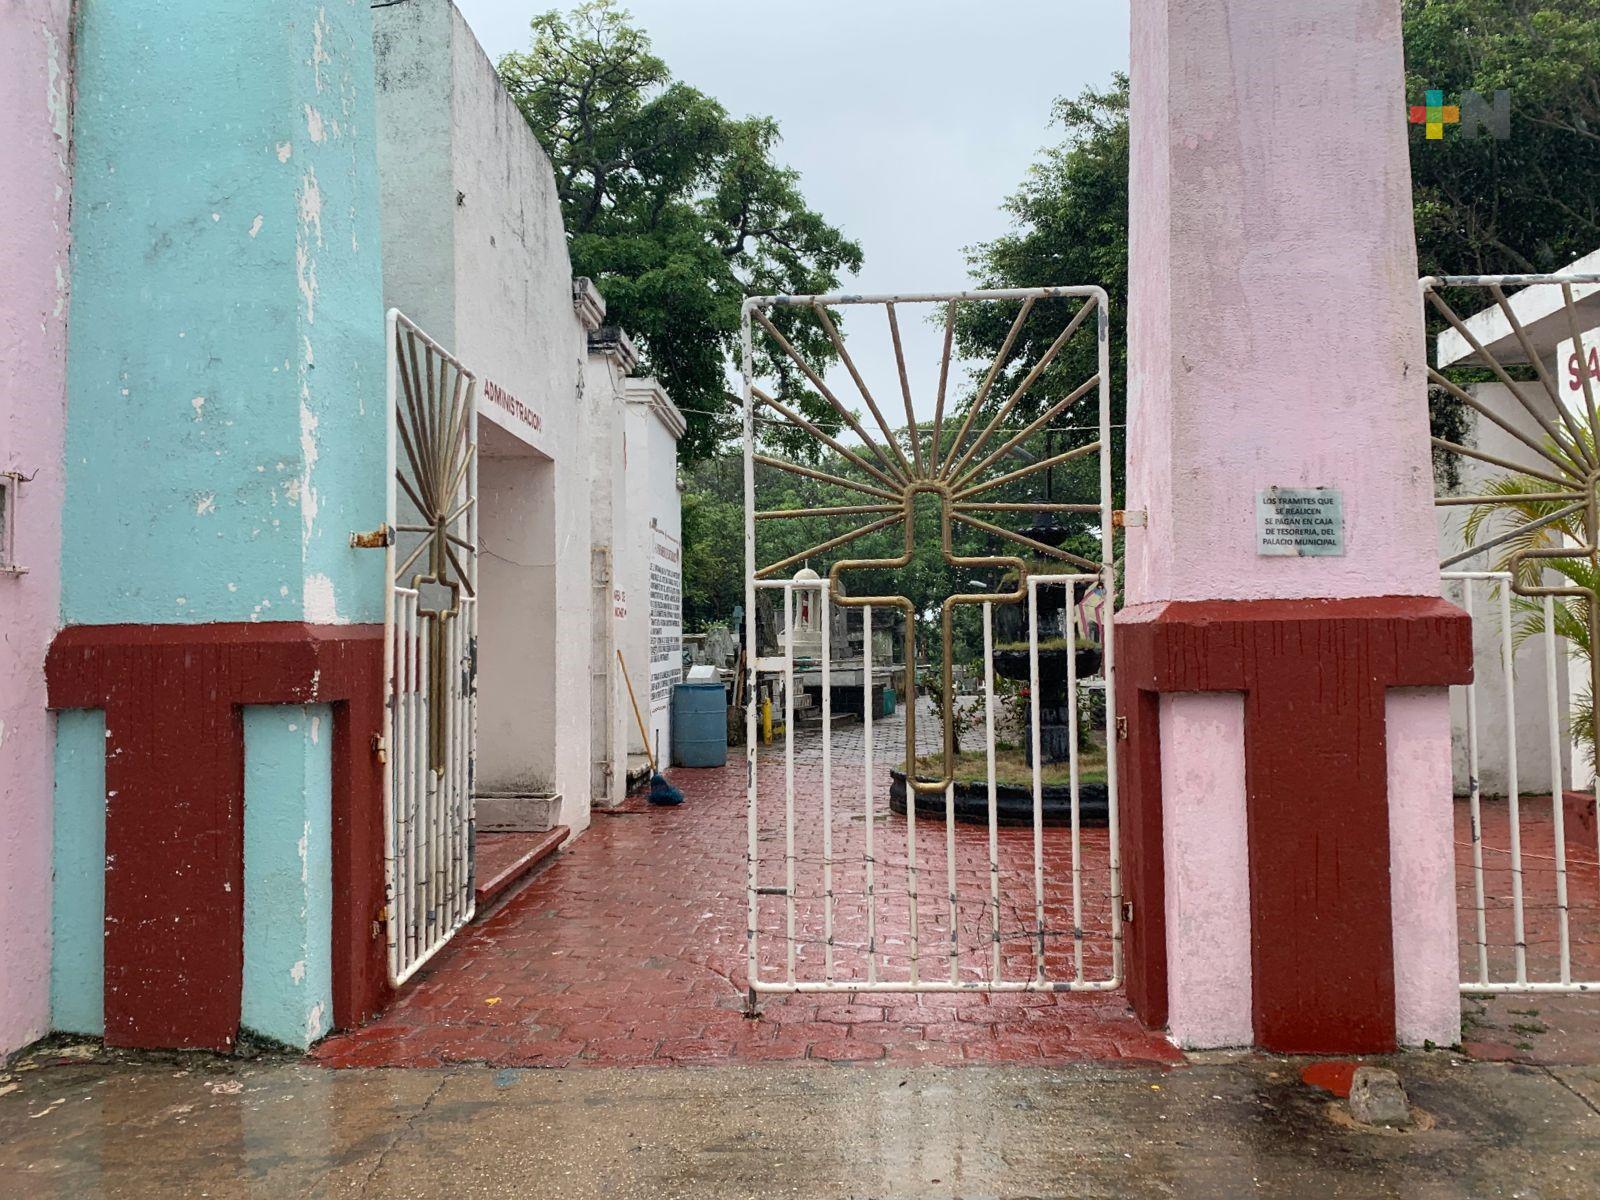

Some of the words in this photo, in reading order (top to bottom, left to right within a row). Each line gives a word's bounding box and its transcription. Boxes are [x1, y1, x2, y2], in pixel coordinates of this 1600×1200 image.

[1262, 497, 1277, 505] LOS
[1278, 497, 1316, 505] TRAMITES
[1317, 497, 1334, 506] QUE
[1275, 507, 1284, 515] SE
[1285, 507, 1322, 515] REALICEN
[1262, 538, 1293, 546] PALACIO
[1294, 538, 1337, 546] MUNICIPAL
